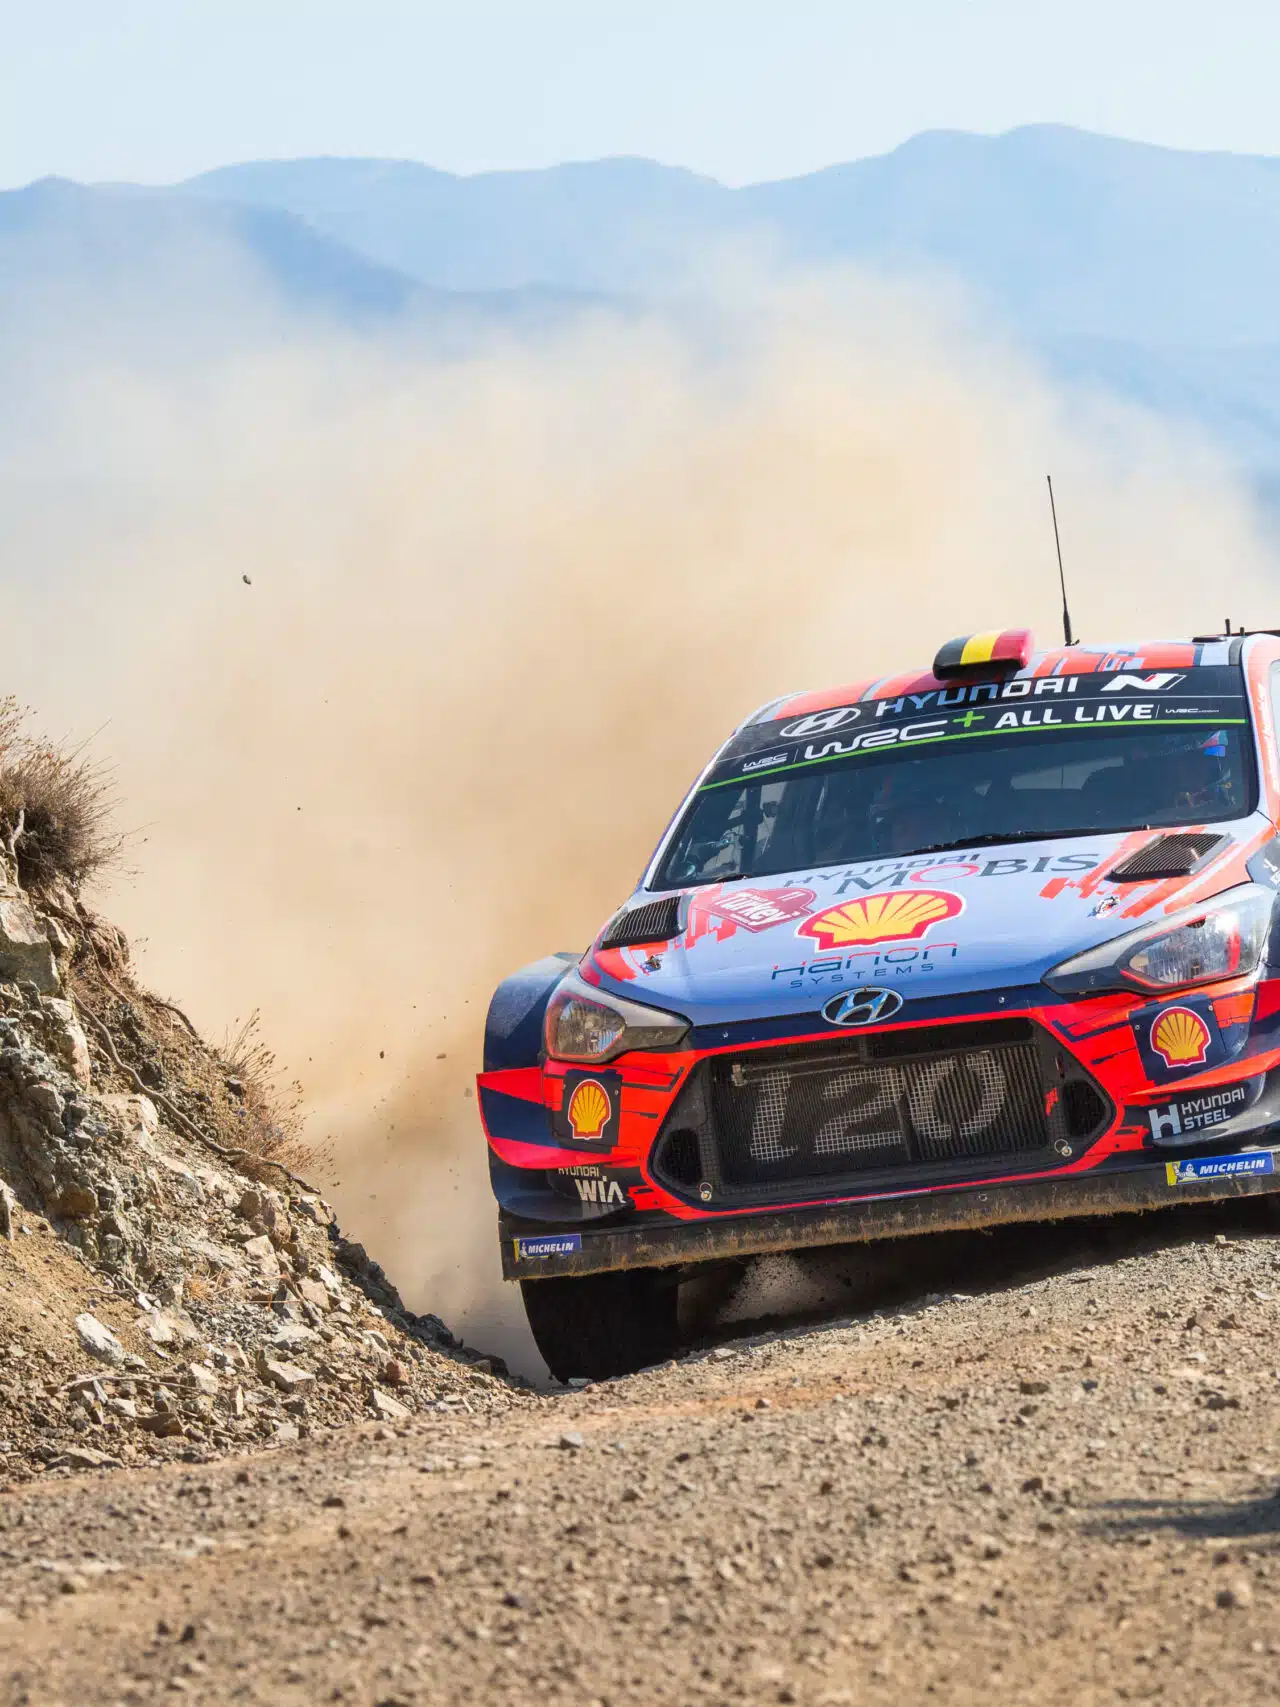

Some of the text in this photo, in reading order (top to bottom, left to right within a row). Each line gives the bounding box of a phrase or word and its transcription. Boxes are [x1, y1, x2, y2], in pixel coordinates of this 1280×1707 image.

[875, 677, 1079, 717] HYUNDAI
[994, 708, 1062, 729] ALL
[1074, 703, 1154, 722] LIVE
[784, 853, 979, 887] HYUNDAI
[833, 853, 1099, 895] MOBIS
[790, 963, 934, 989] SYSTEMS
[1181, 1087, 1245, 1116] HYUNDAI
[1184, 1108, 1231, 1130] STEEL
[1199, 1159, 1266, 1175] MICHELIN
[528, 1242, 574, 1254] MICHELIN
